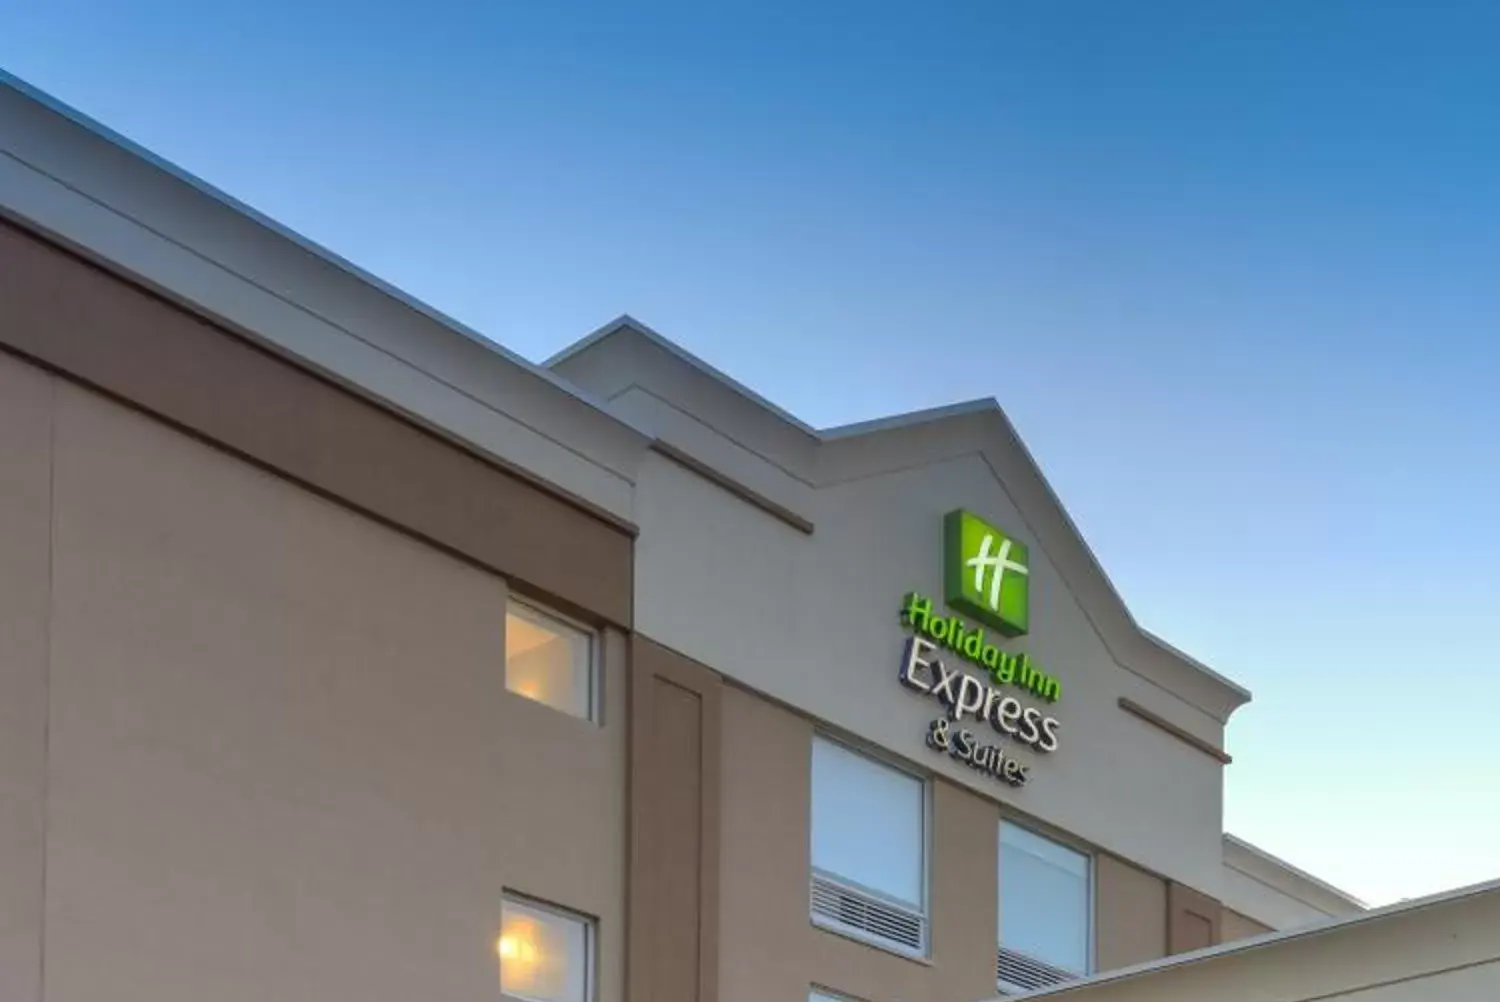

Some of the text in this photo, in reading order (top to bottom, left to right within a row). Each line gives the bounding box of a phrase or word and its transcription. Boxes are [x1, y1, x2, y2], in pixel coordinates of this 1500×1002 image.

[903, 635, 1060, 751] Express
[907, 592, 1062, 701] Holiday Inn
[930, 717, 1030, 783] & Suites
